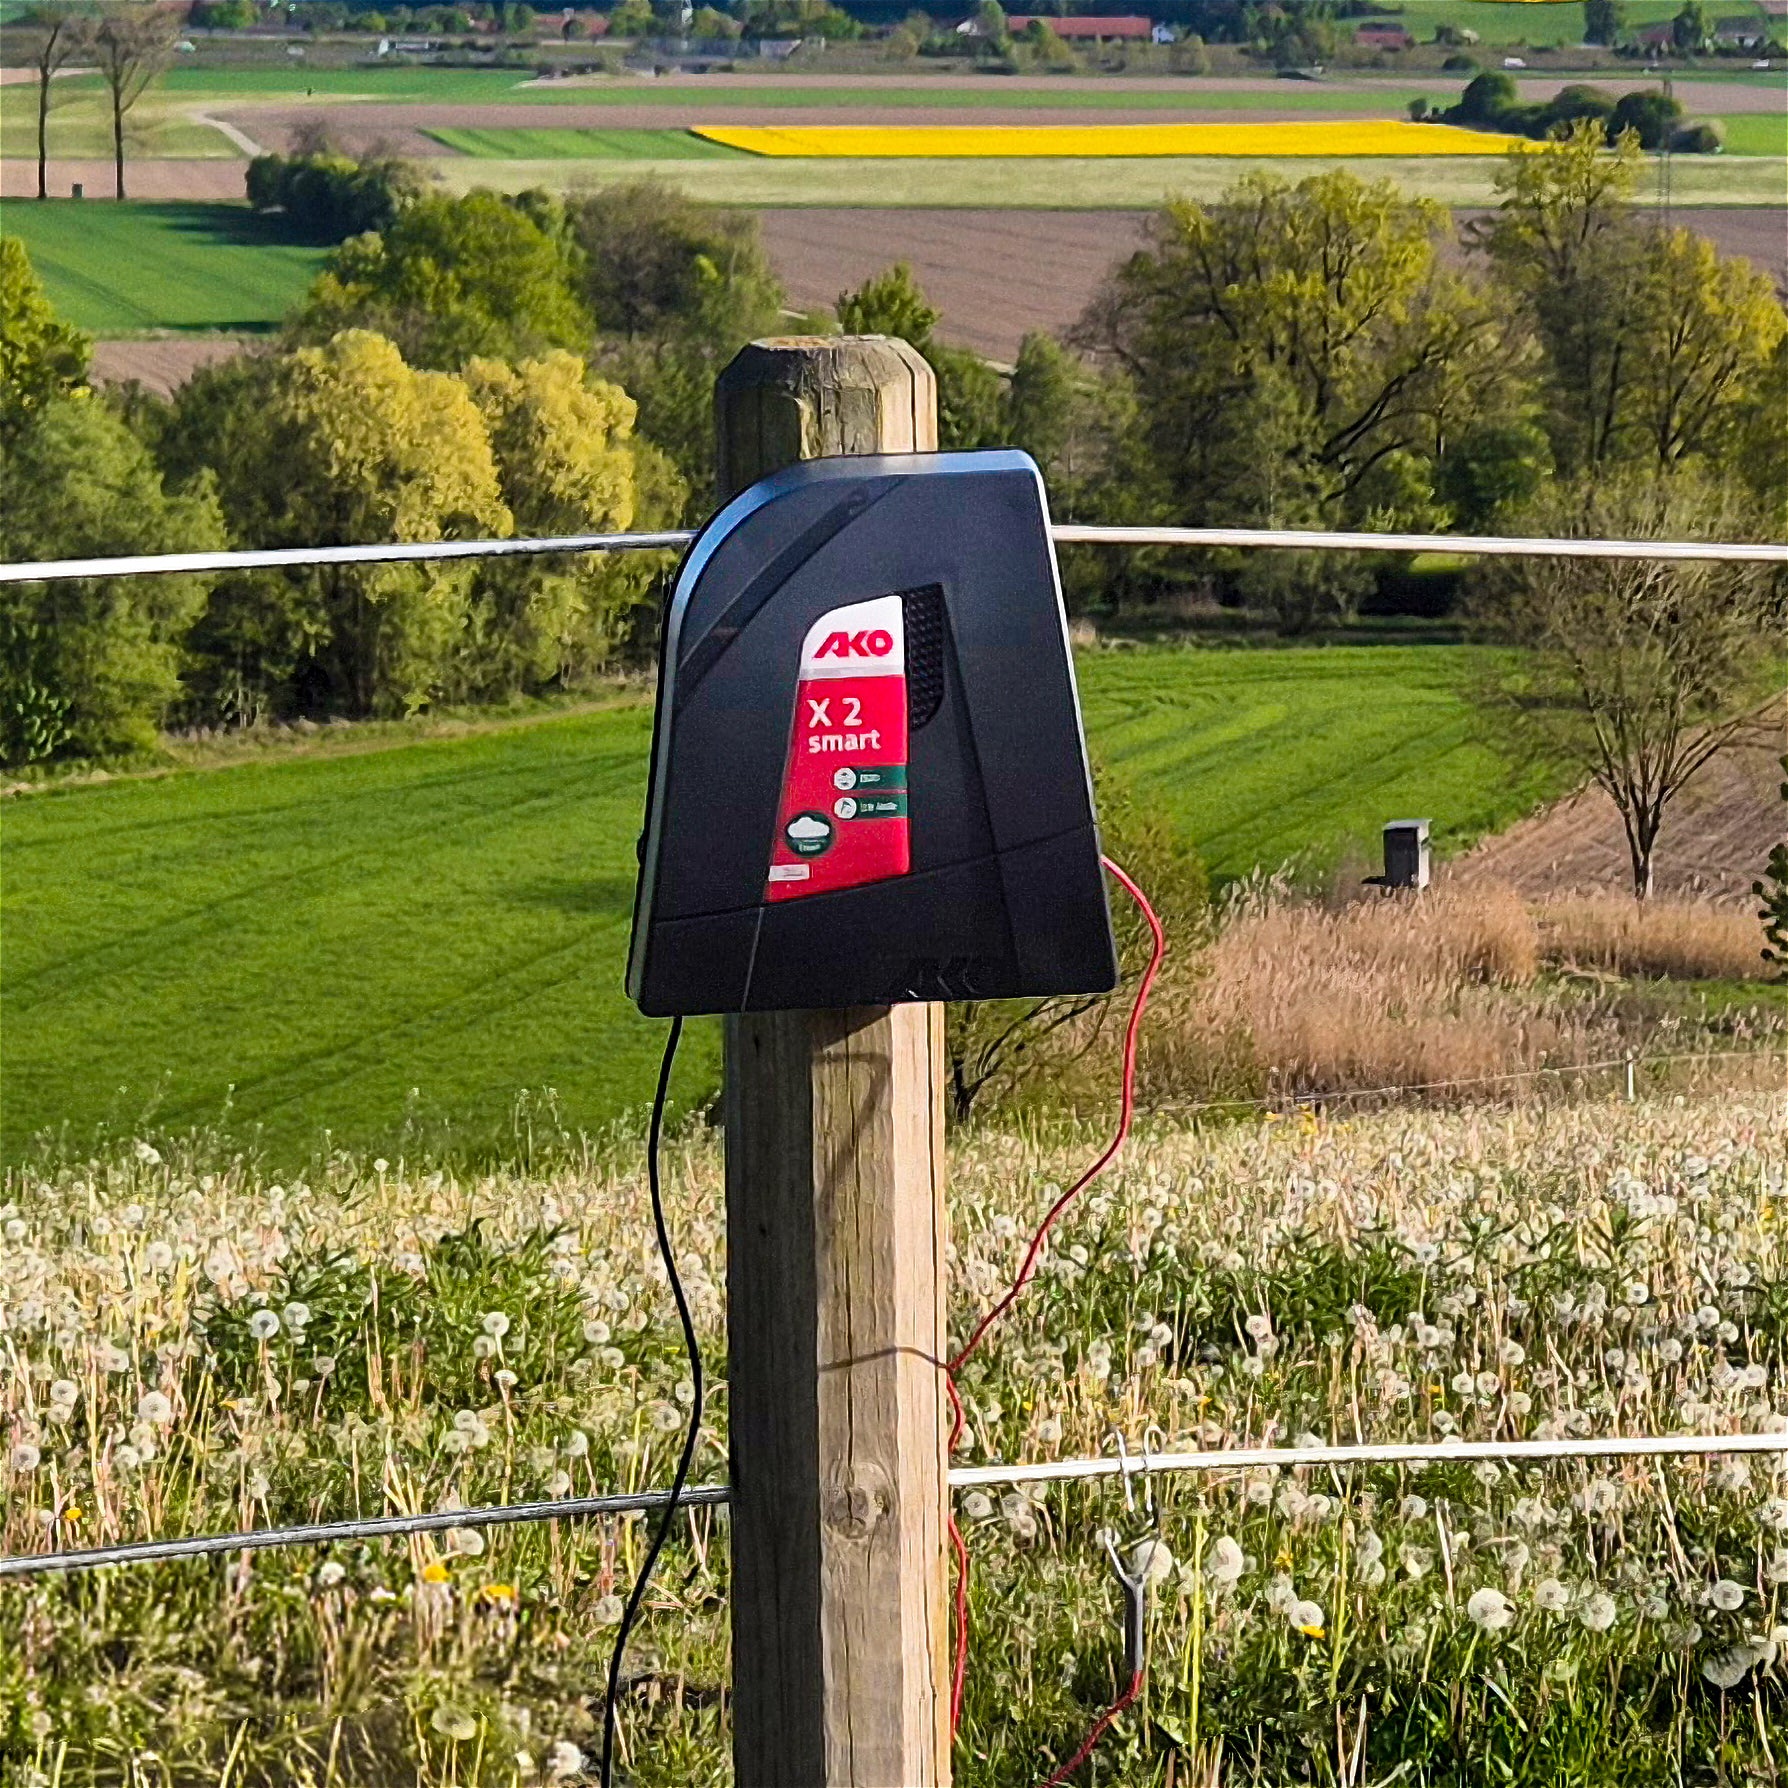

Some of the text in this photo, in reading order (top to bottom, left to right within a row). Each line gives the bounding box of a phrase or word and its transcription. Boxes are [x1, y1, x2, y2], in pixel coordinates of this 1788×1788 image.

[813, 629, 894, 658] AKO
[807, 697, 862, 728] X 2
[808, 729, 881, 753] smart
